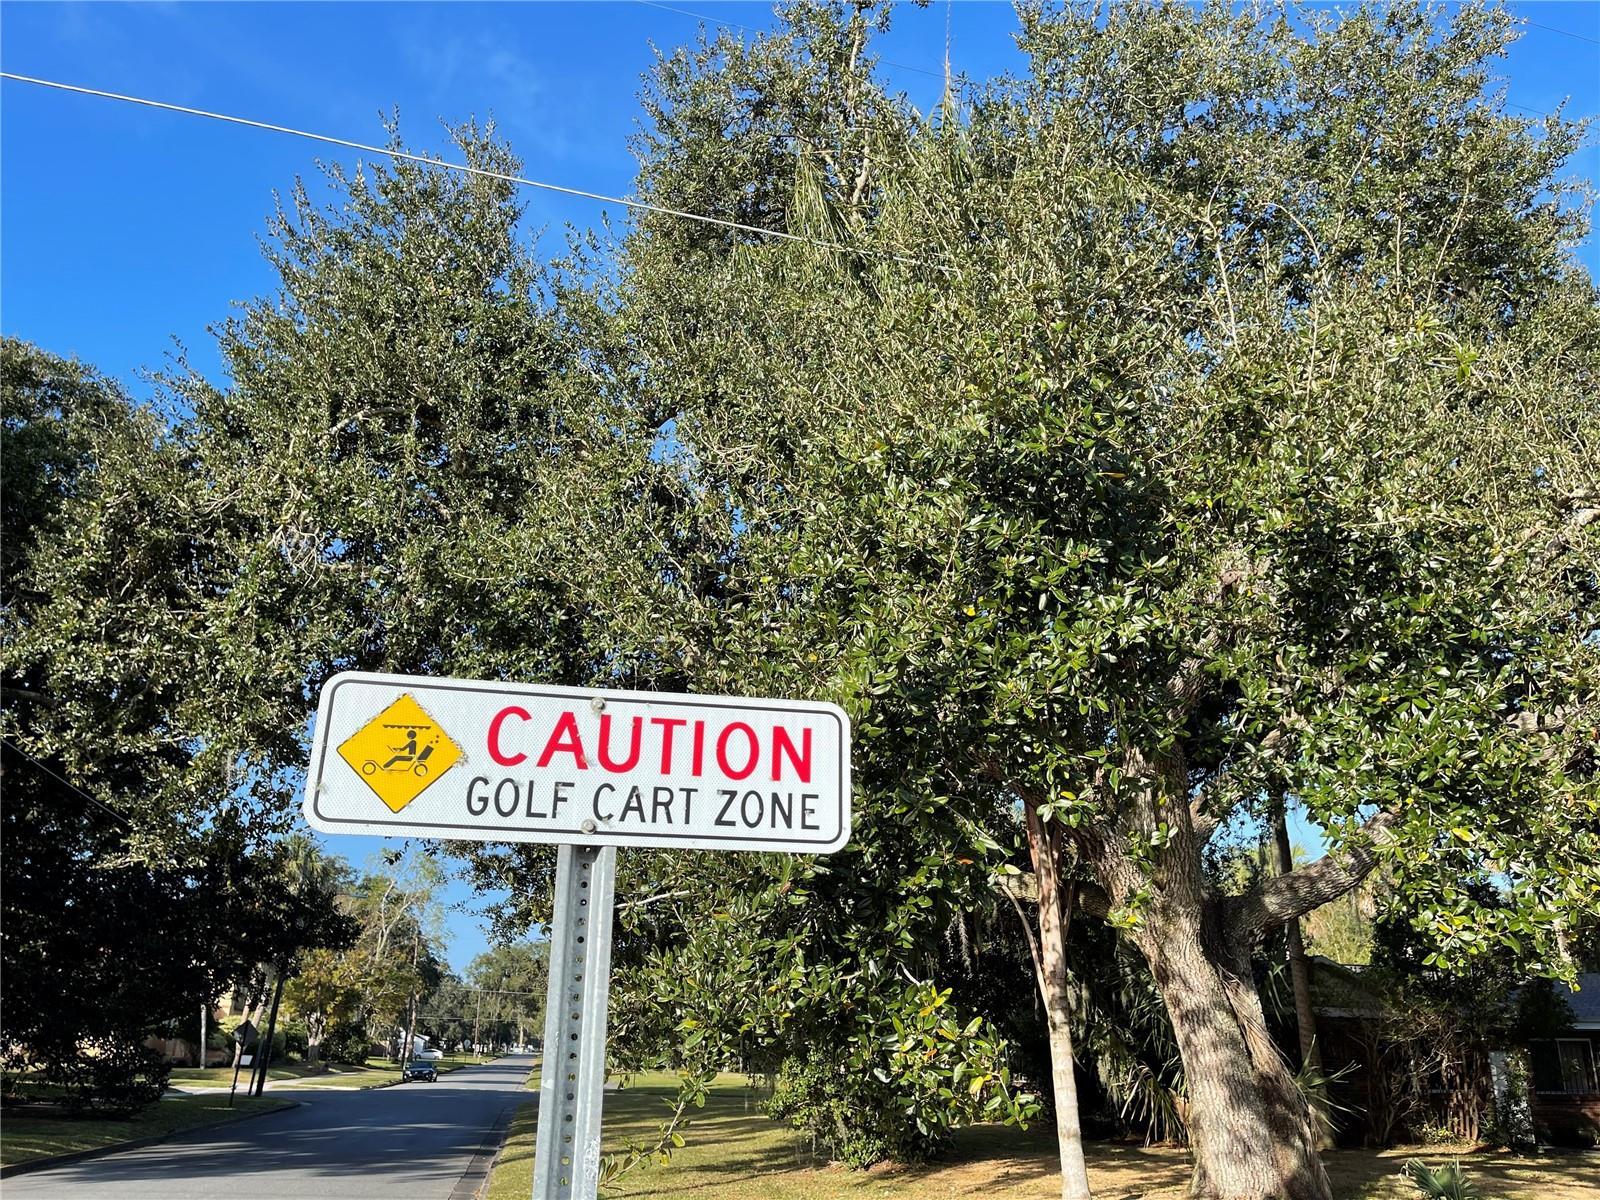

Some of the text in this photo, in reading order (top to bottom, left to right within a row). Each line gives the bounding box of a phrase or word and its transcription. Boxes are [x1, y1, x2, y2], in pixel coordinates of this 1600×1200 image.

[487, 705, 812, 783] CAUTION
[466, 776, 820, 830] GOLF CART ZONE
